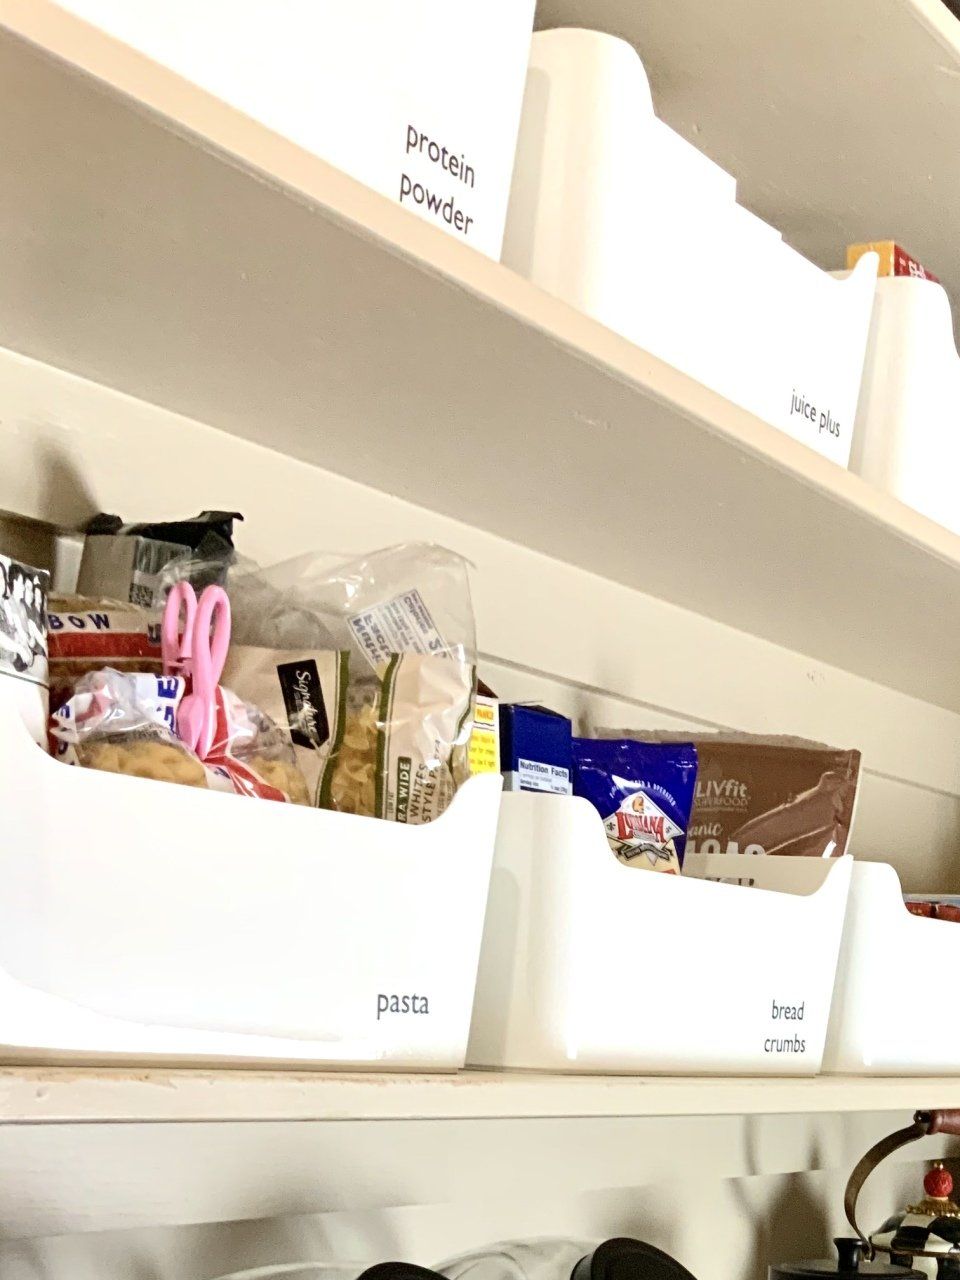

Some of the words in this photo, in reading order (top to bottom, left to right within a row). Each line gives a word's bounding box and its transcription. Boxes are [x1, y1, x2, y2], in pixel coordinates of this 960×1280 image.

[406, 124, 475, 188] protein
[400, 173, 474, 235] powder
[790, 388, 817, 422] juice
[819, 409, 840, 438] plus
[48, 613, 111, 630] BOW
[399, 762, 410, 796] WIDE
[410, 763, 428, 818] WHITES
[696, 779, 748, 798] LIVfit
[422, 782, 437, 822] STYLE
[376, 992, 430, 1020] pasta
[771, 999, 804, 1021] bread
[764, 1034, 806, 1053] crumbs
